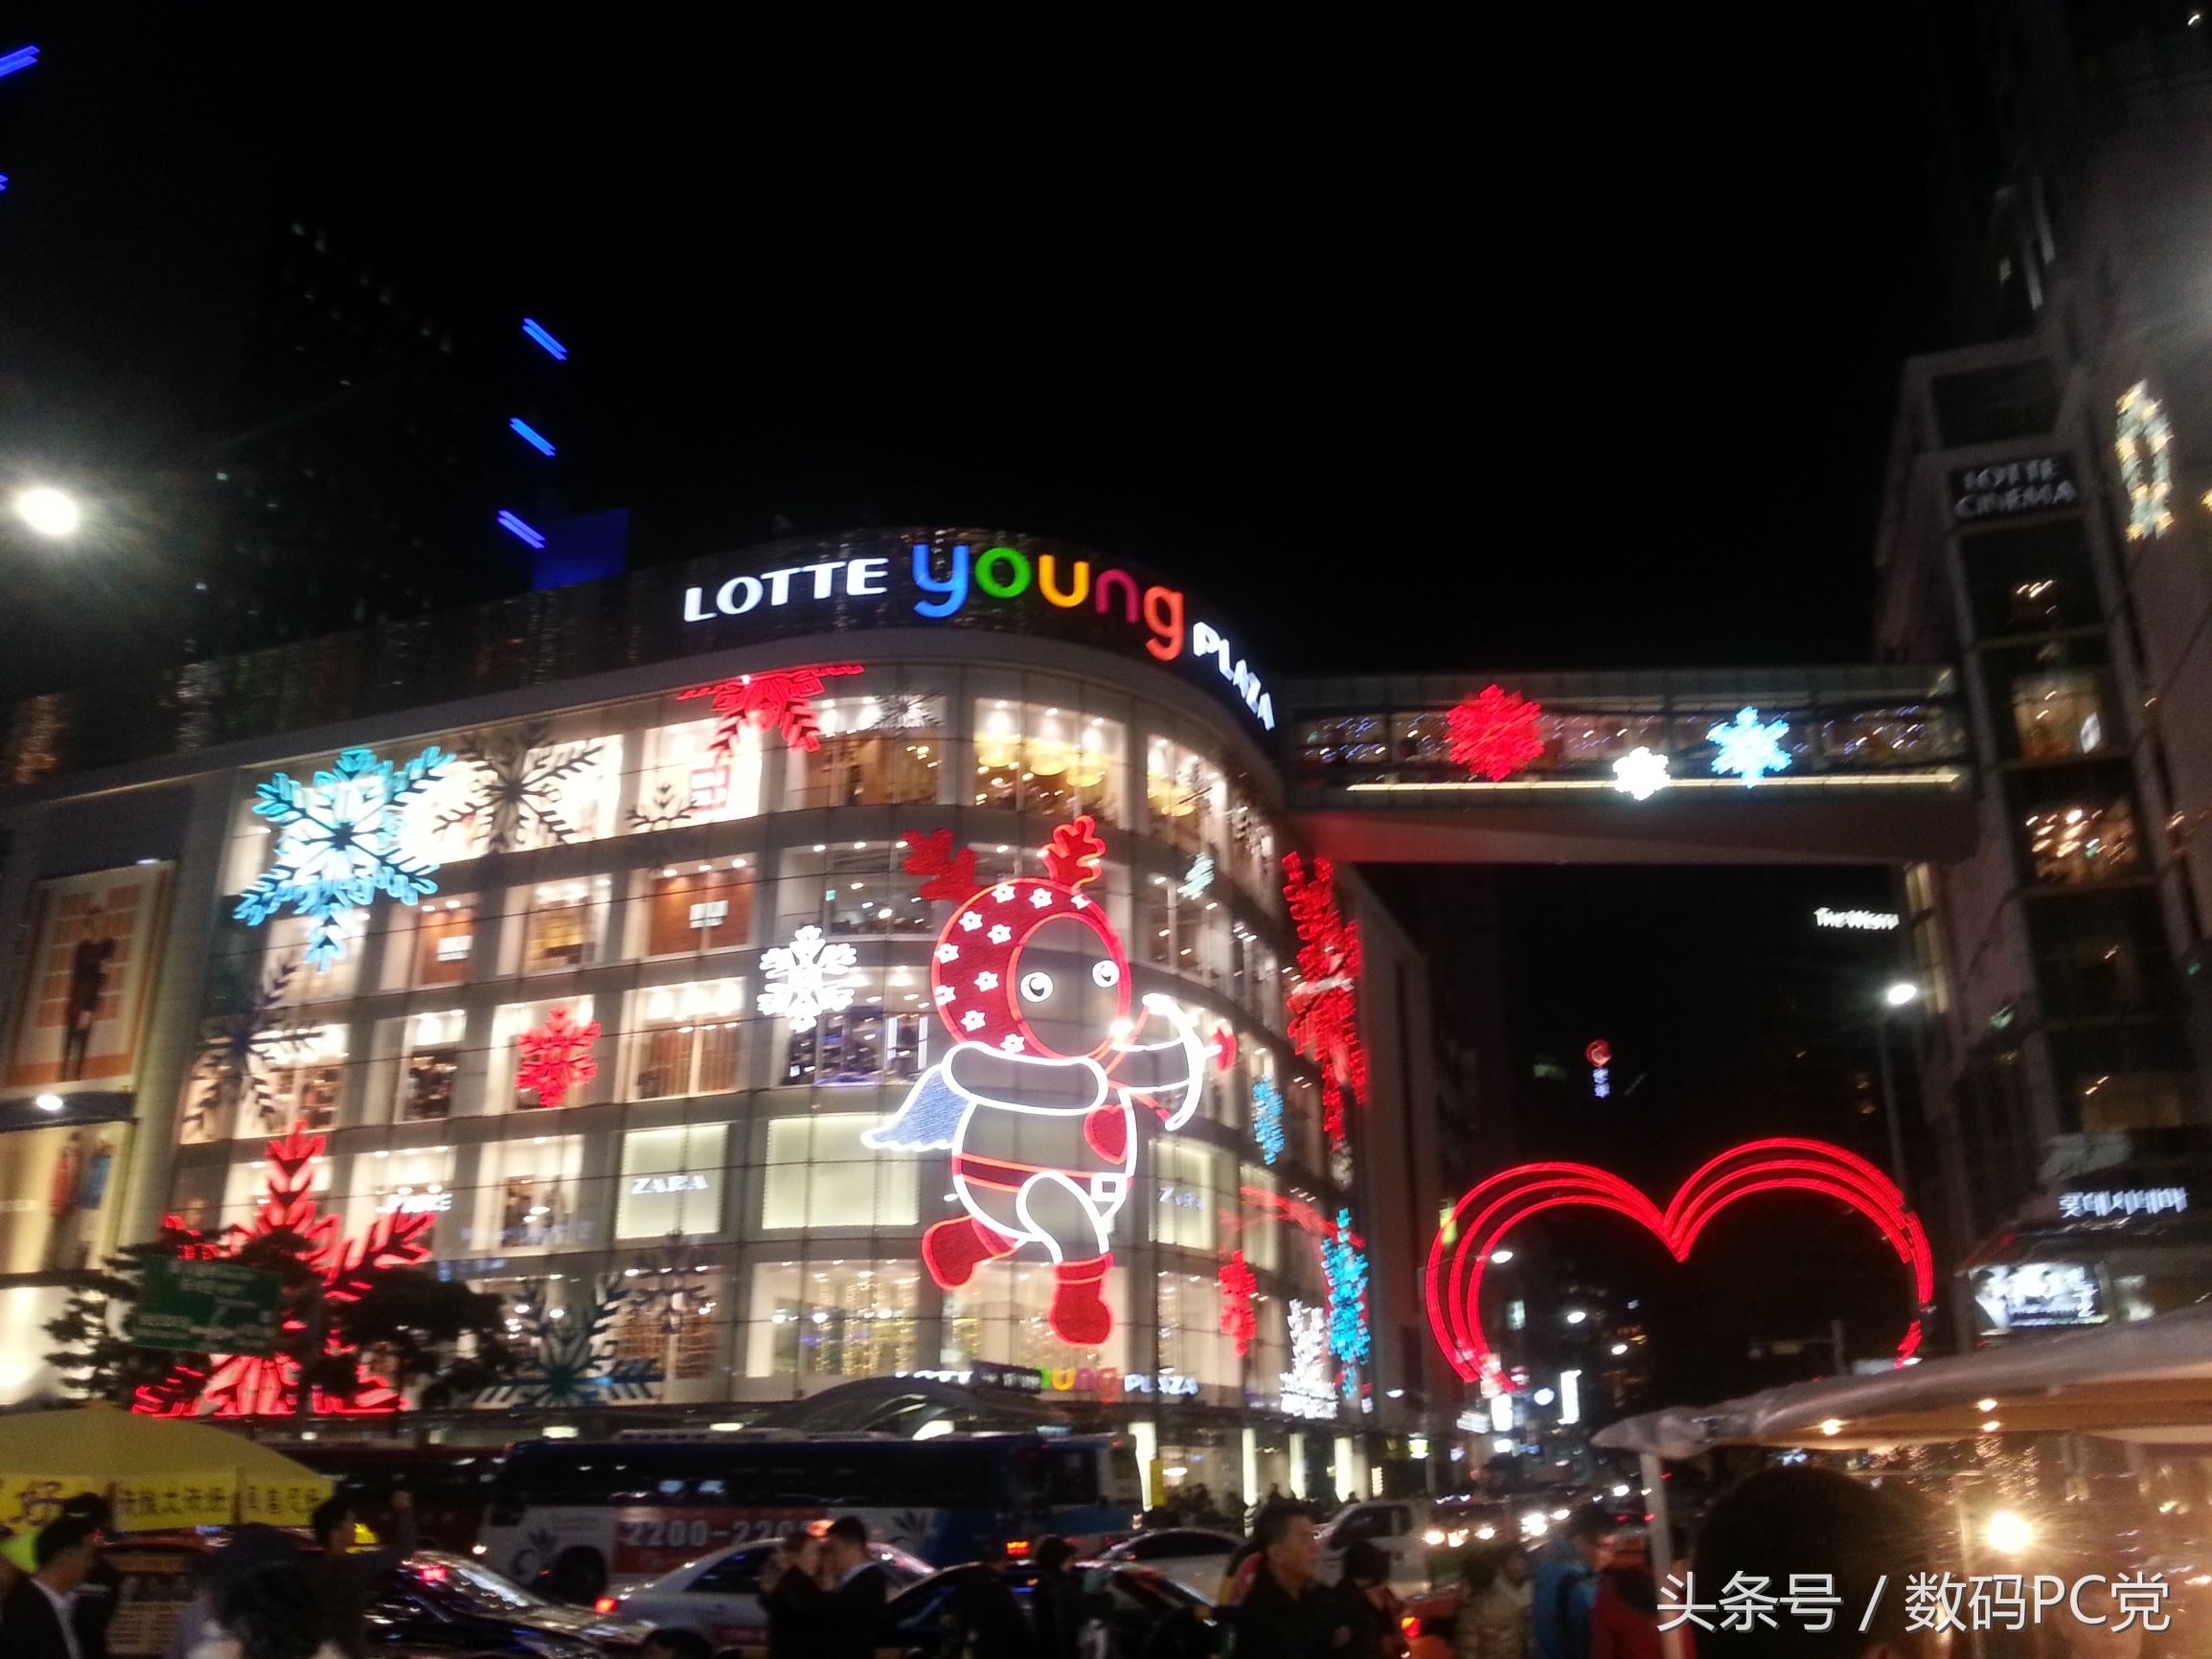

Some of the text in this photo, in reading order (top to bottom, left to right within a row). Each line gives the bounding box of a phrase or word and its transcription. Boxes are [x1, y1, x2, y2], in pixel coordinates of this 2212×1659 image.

[683, 543, 1276, 732] LOTTE young PLAZA
[630, 1174, 710, 1195] ZARA
